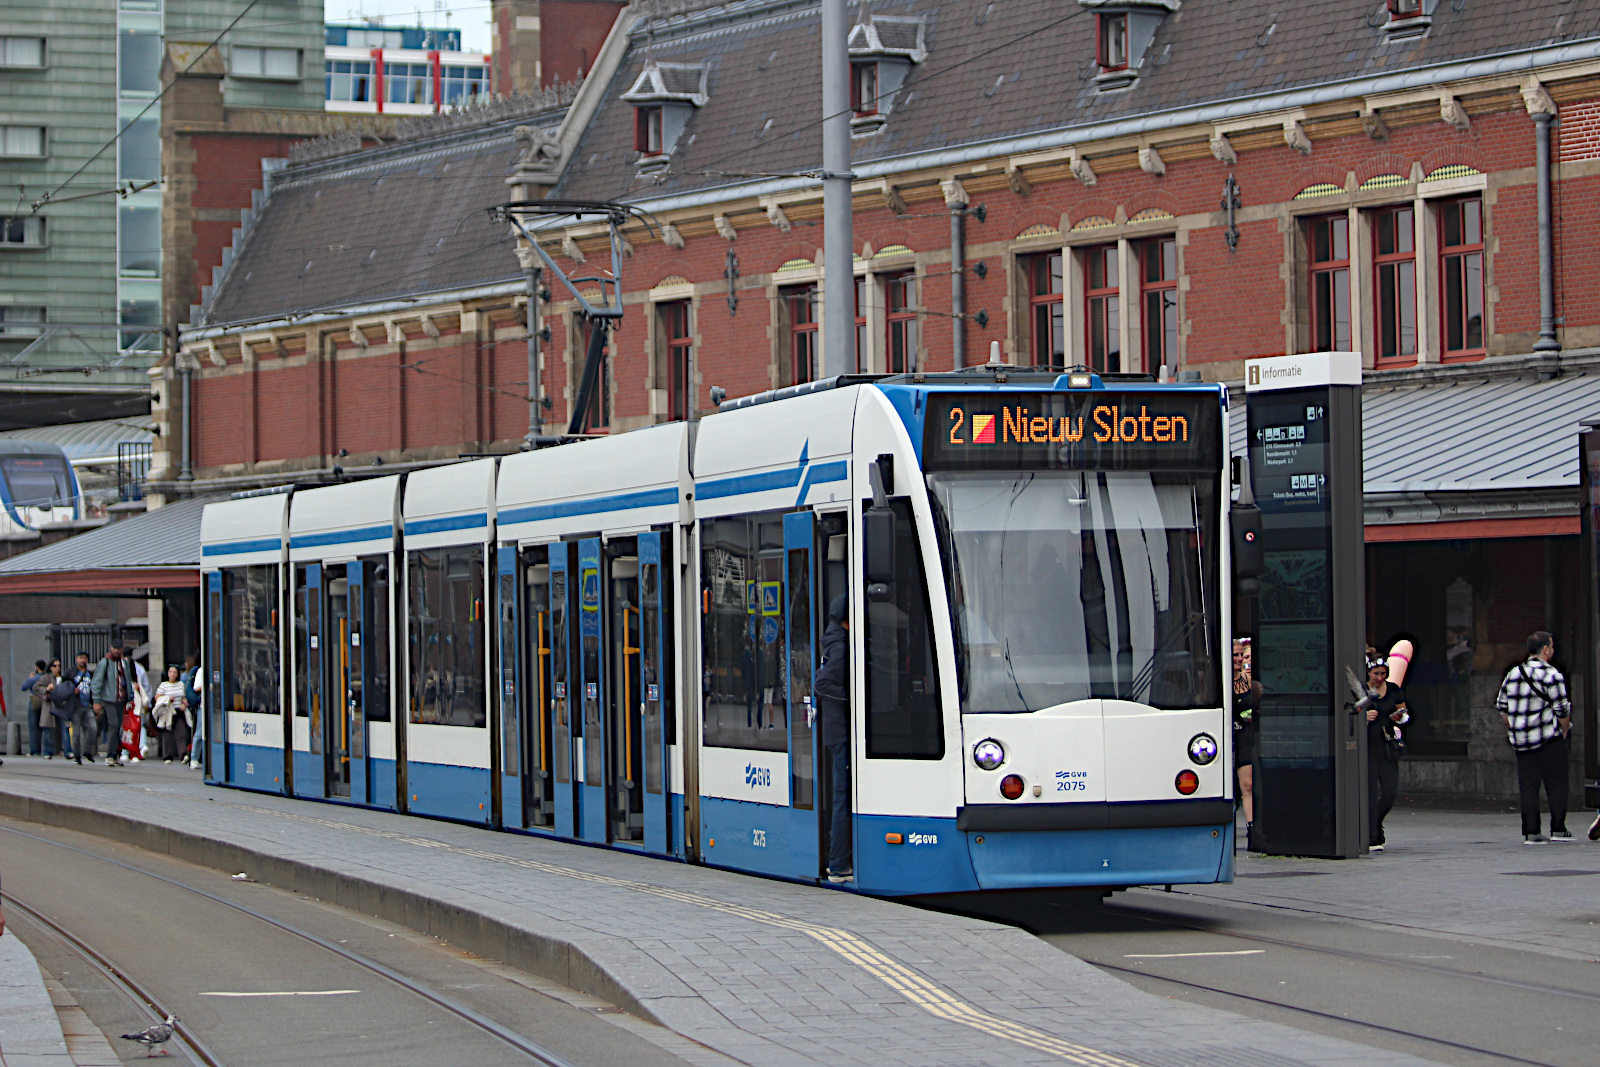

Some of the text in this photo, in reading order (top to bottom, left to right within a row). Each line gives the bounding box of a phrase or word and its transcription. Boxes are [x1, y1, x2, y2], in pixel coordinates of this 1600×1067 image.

[1262, 365, 1302, 379] Informatie
[949, 405, 1189, 444] 2 Nieuw Sloten
[757, 766, 771, 787] GVB
[1056, 781, 1087, 792] 2075
[922, 834, 938, 845] GVB
